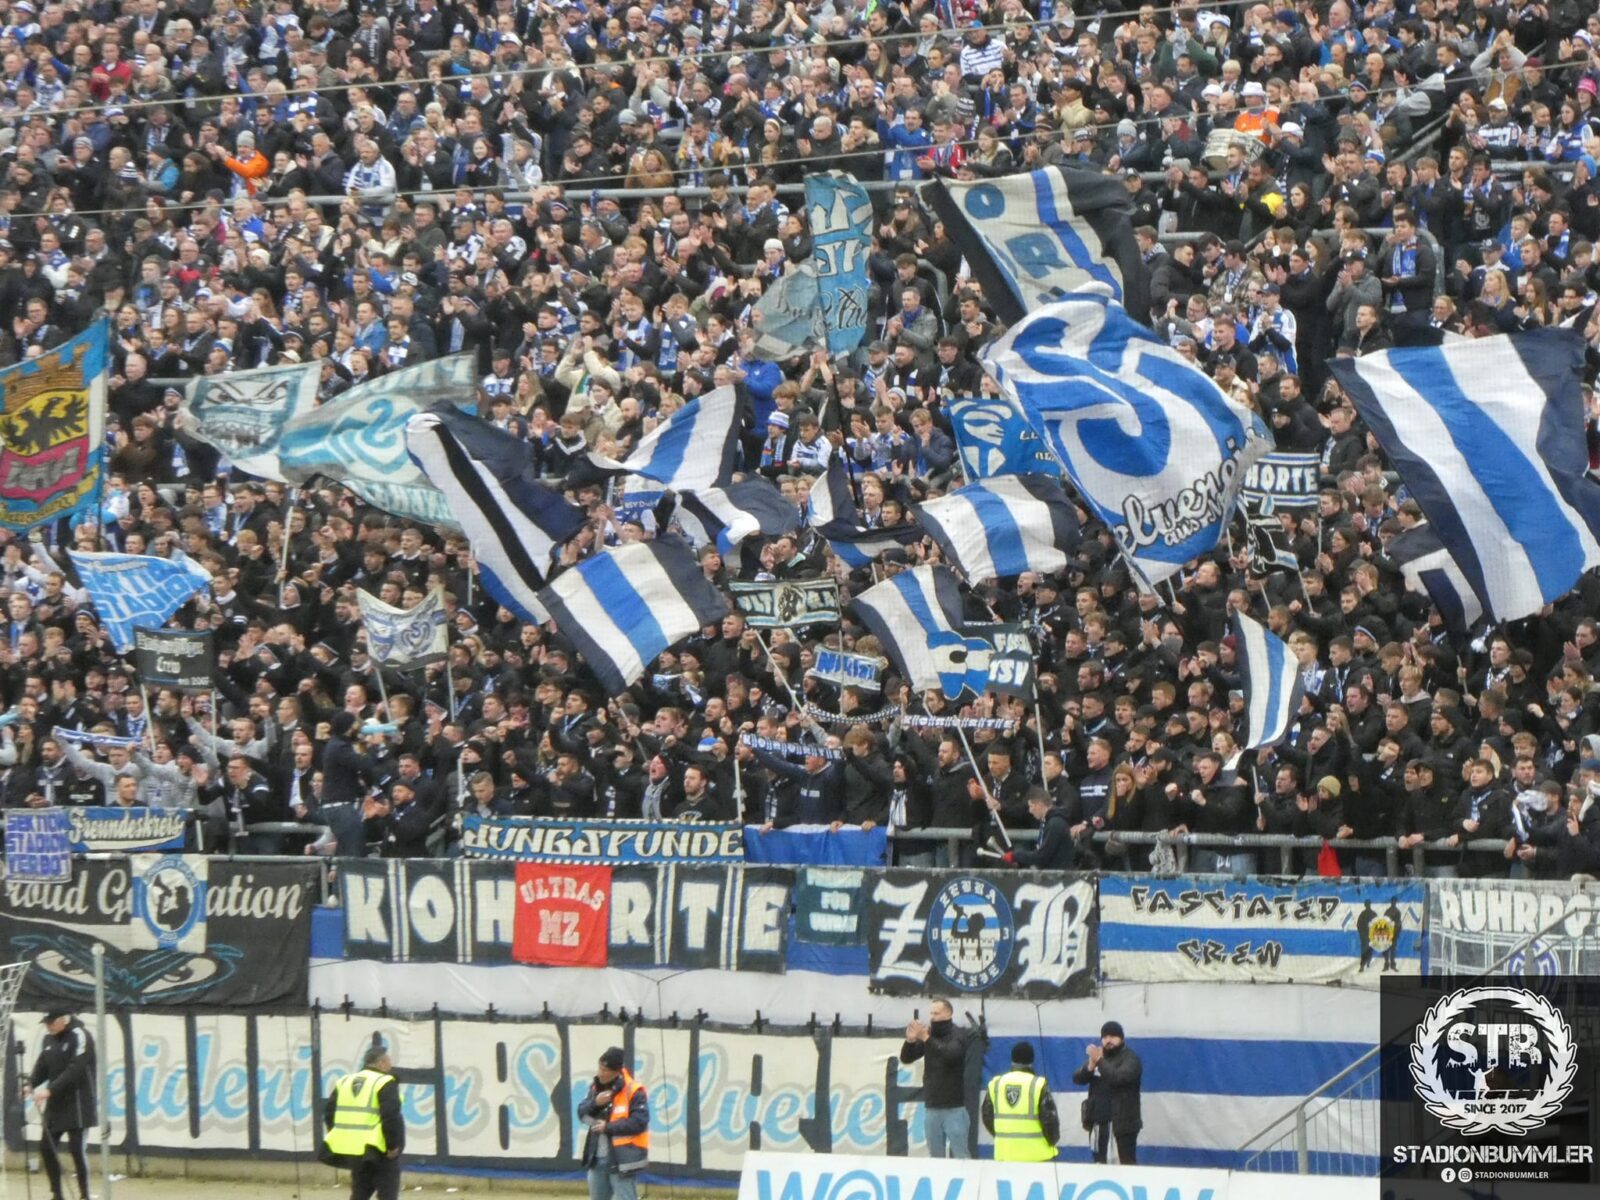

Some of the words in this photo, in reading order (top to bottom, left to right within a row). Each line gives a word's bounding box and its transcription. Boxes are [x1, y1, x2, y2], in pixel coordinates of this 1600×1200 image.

[1244, 464, 1318, 493] HORTE
[69, 807, 185, 842] Freundeskreis
[0, 868, 89, 915] roud
[97, 868, 303, 922] Gation
[520, 876, 605, 912] ULTRAS
[345, 873, 787, 953] KOHRTE
[538, 909, 580, 946] MZ
[1177, 939, 1282, 968] CREW
